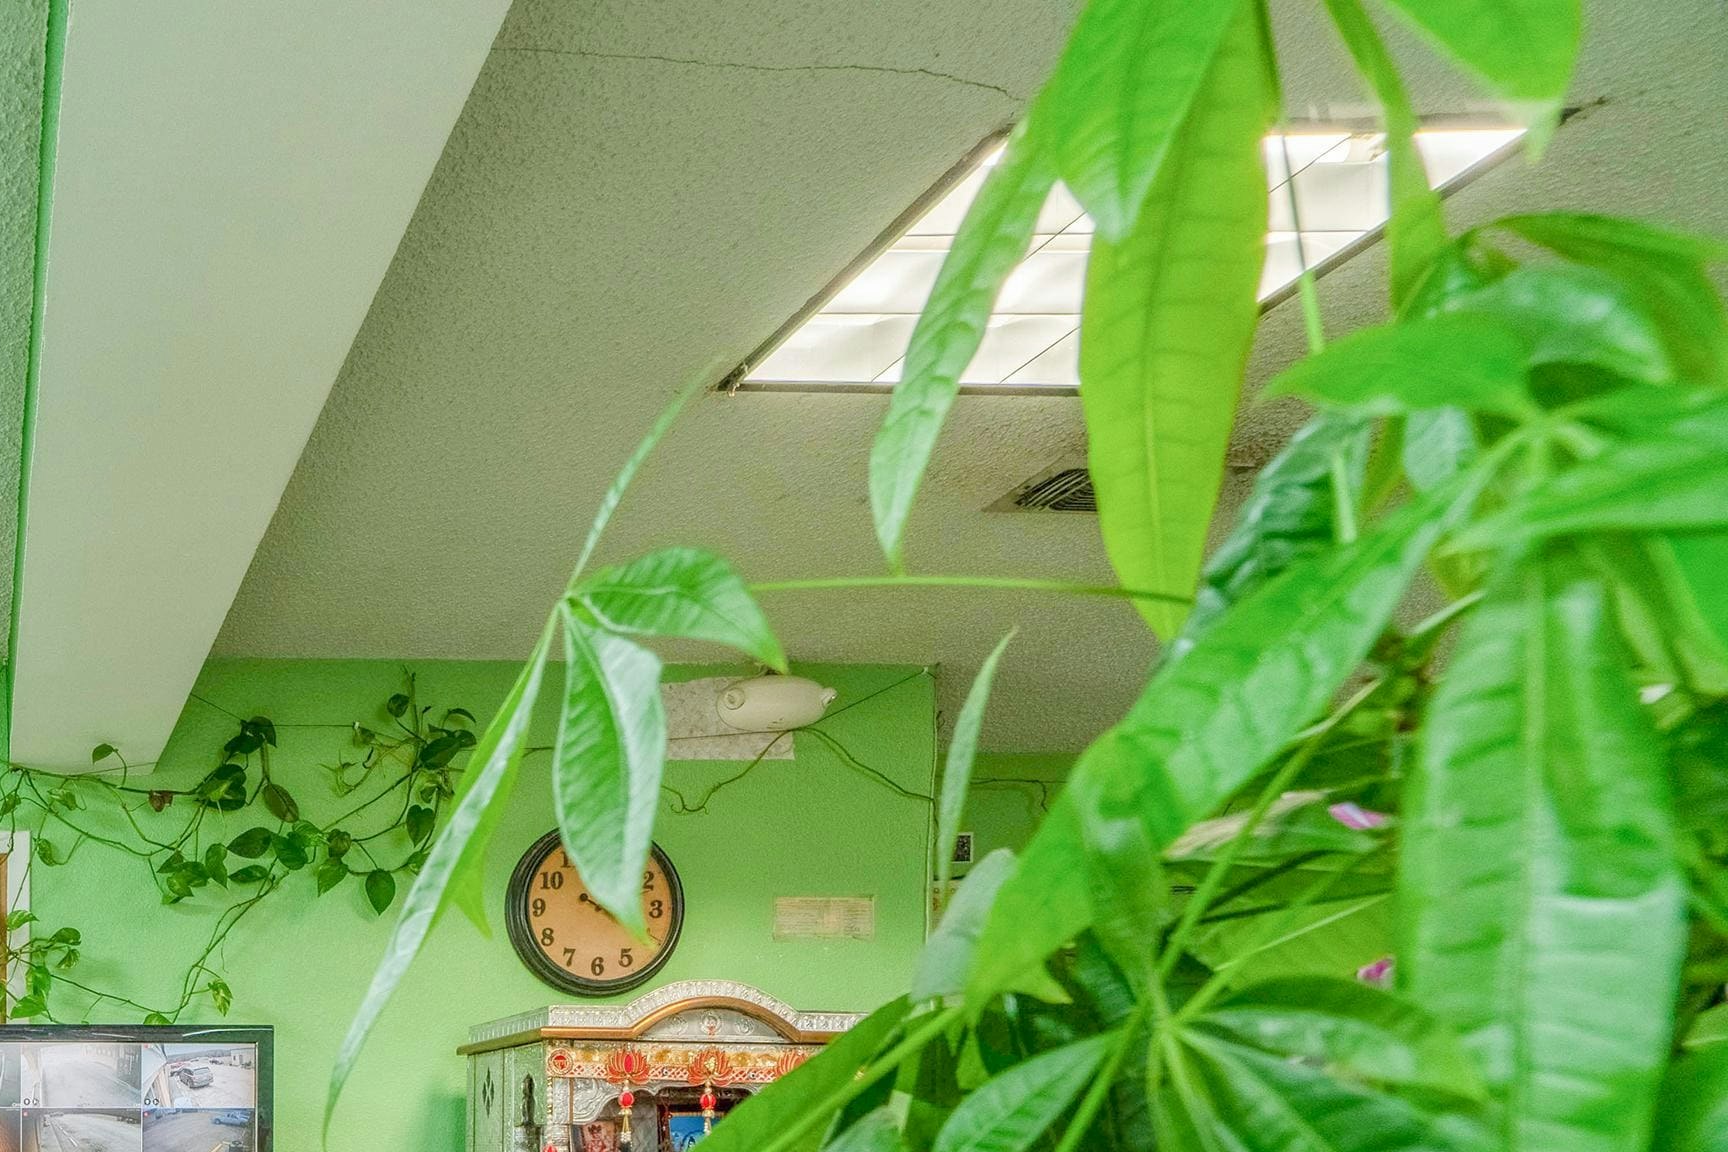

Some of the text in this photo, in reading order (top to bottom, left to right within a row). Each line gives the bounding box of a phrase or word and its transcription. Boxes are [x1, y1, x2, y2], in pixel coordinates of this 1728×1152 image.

[560, 851, 573, 868] 1
[539, 871, 564, 890] 10
[643, 871, 654, 891] 2
[532, 898, 546, 918] 9
[649, 900, 663, 918] 3
[540, 927, 554, 947] 8
[562, 947, 576, 967] 7
[591, 956, 604, 976] 6
[618, 948, 633, 967] 5
